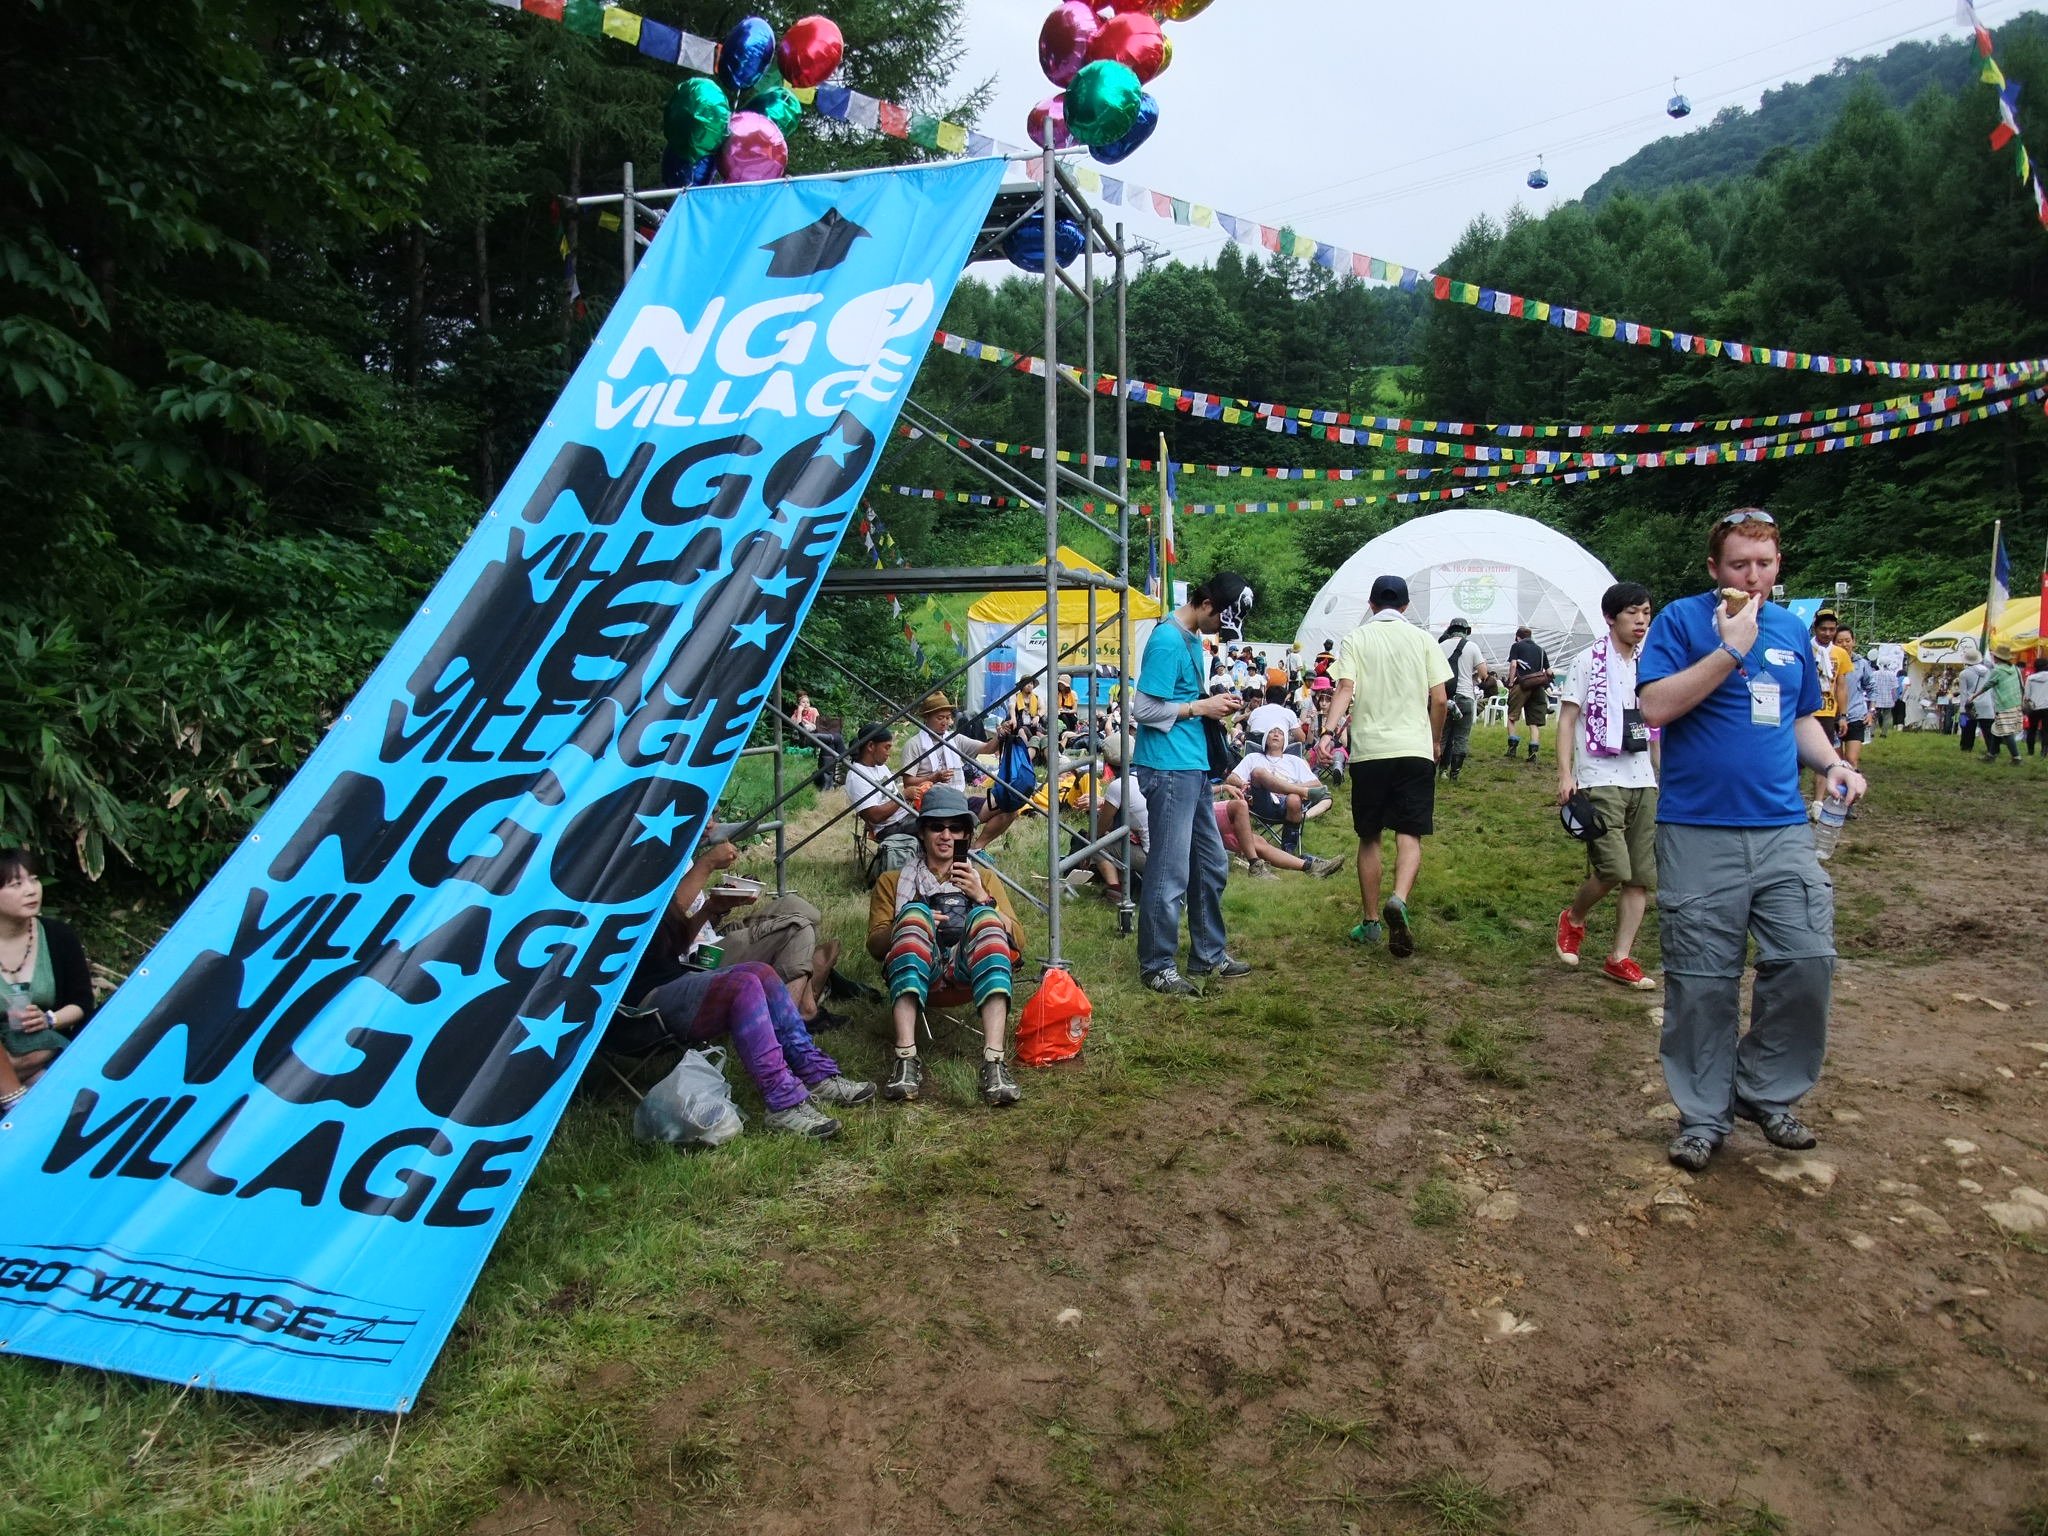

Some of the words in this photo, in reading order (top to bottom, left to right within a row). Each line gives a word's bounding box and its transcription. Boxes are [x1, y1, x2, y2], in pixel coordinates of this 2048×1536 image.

[607, 278, 935, 380] NGO
[595, 347, 912, 430] VILLAGE
[521, 410, 875, 526] NGO
[268, 771, 710, 904] NGO
[228, 887, 652, 986] VILLAGE
[102, 949, 600, 1128] NGO
[41, 1087, 533, 1228] VILLAGE
[88, 1267, 337, 1342] VILLAGE
